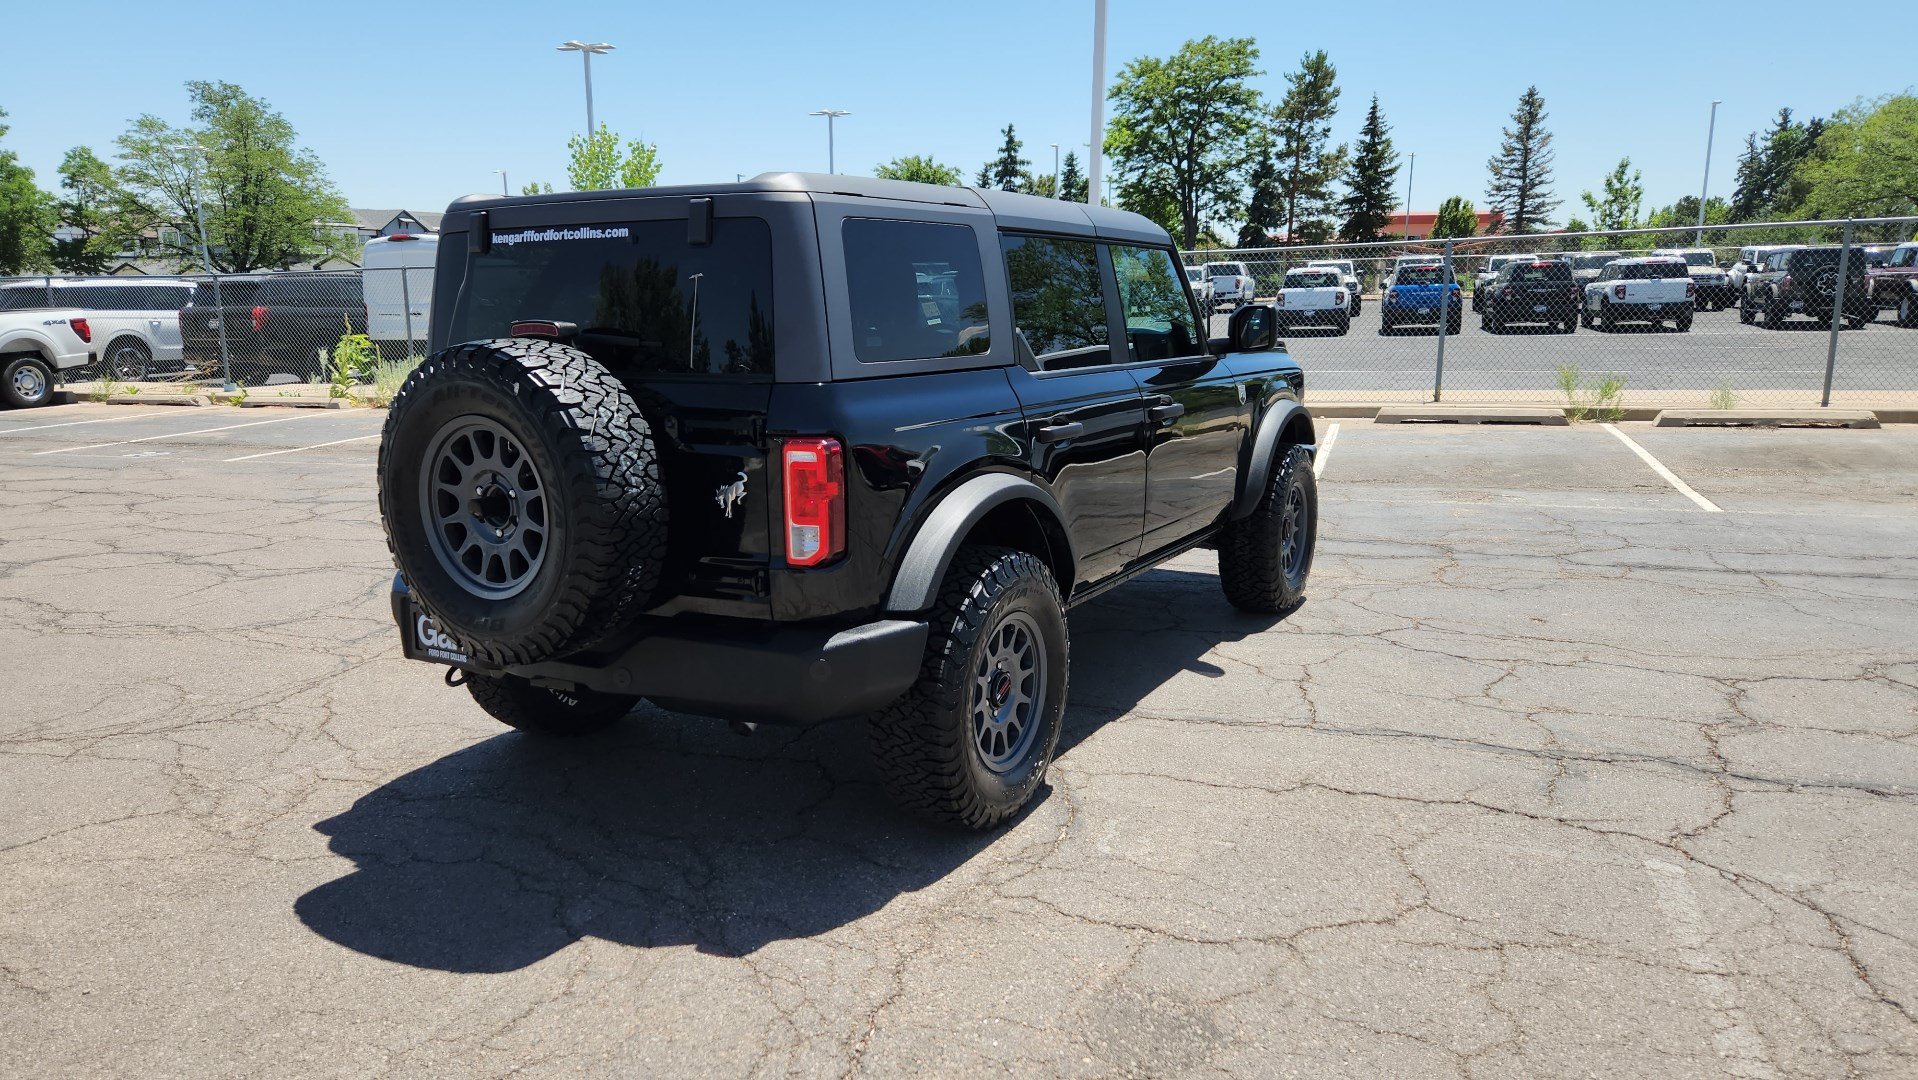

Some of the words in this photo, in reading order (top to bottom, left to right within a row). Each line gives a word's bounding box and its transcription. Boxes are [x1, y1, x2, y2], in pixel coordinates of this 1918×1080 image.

[492, 227, 629, 245] kengarfffordfortcollins.com
[428, 648, 440, 658] FORD
[439, 650, 450, 660] FORT
[450, 652, 468, 663] COLLINS
